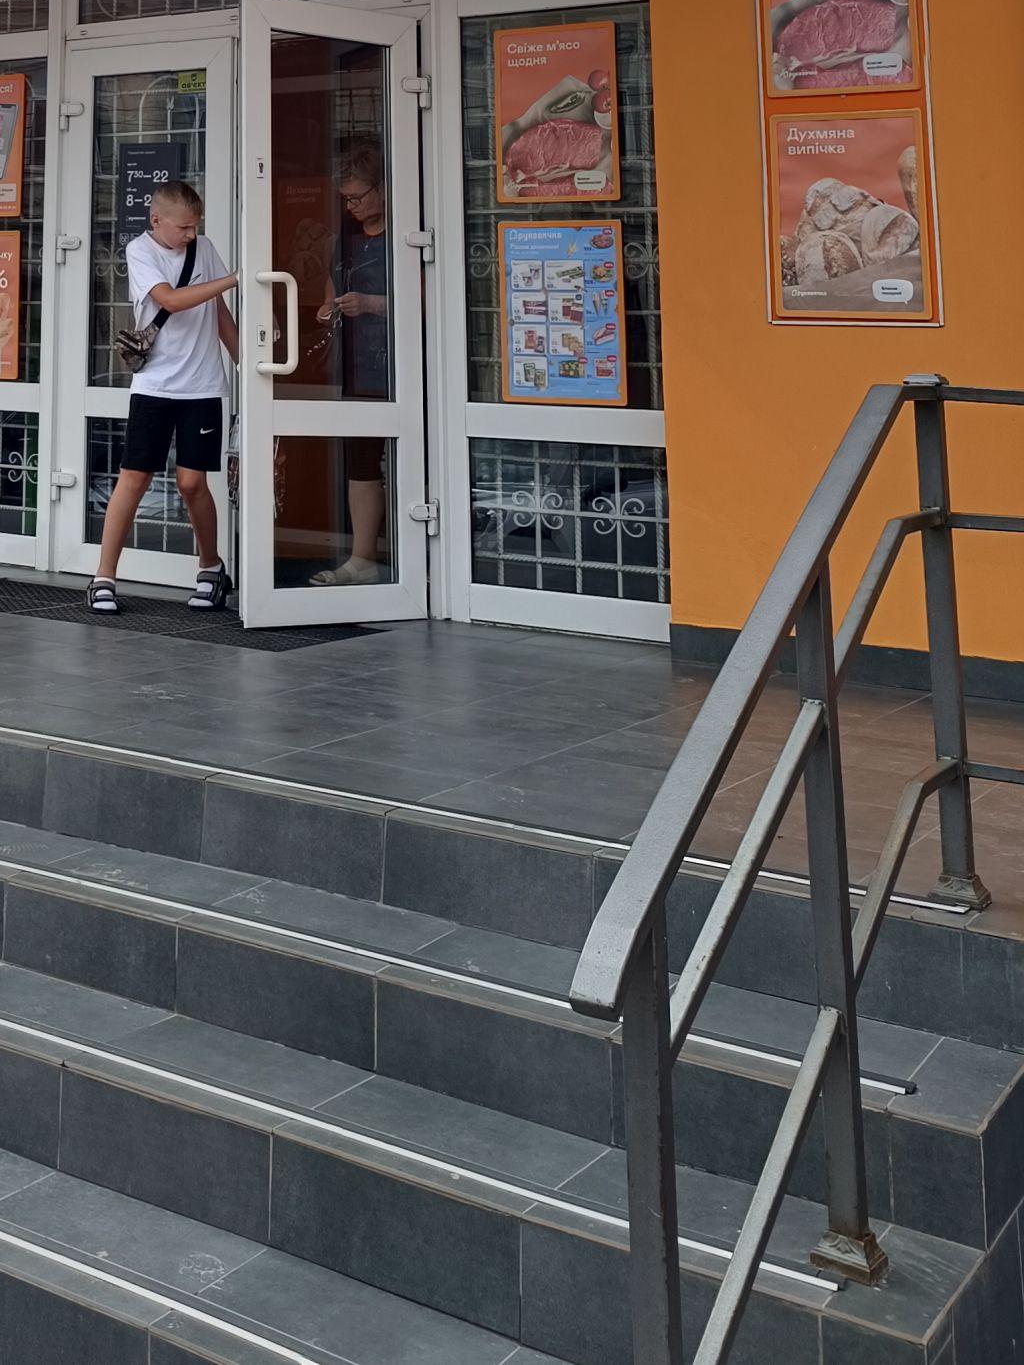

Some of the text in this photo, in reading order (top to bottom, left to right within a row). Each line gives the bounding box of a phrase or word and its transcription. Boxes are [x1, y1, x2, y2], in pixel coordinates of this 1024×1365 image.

[507, 40, 580, 54] Свіже м'ясо
[507, 56, 547, 68] щодня
[786, 127, 856, 143] Духмяна
[788, 142, 846, 155] випічка
